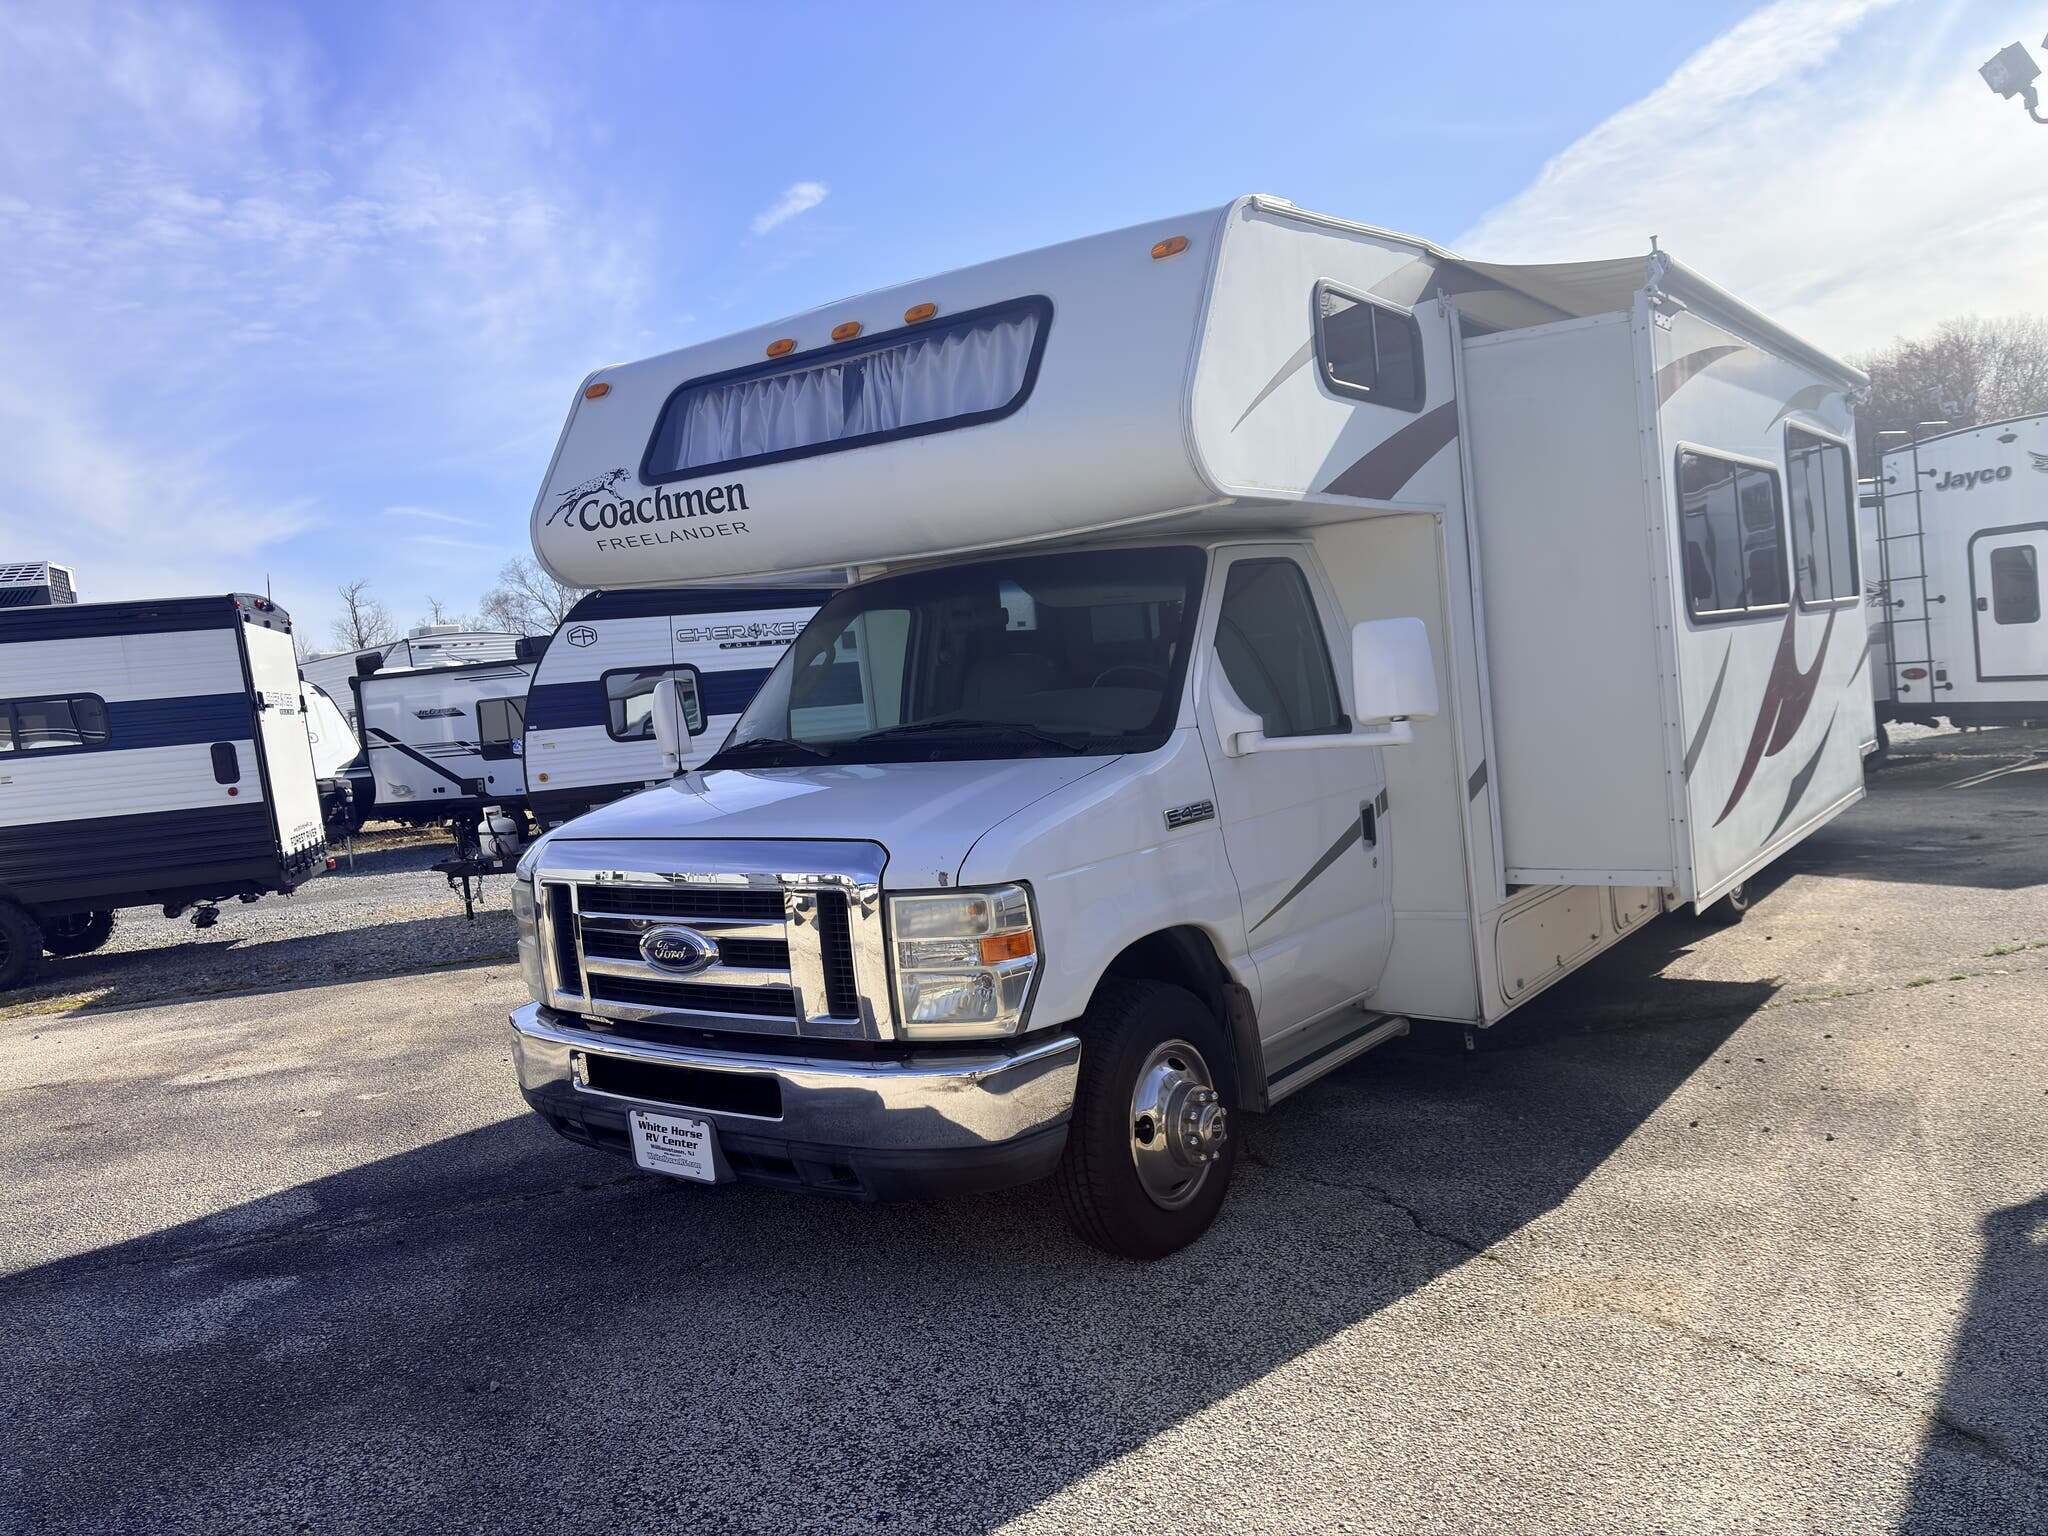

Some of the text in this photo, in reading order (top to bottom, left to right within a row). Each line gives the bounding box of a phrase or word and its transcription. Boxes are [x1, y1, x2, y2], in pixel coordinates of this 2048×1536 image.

[1936, 466, 2012, 491] Jayco
[579, 482, 750, 532] Coachmen
[596, 521, 751, 552] FREELANDER
[290, 827, 317, 846] FOREST RIVER
[654, 940, 688, 960] Ford
[638, 1120, 703, 1140] White Horse
[645, 1132, 698, 1150] RV Center
